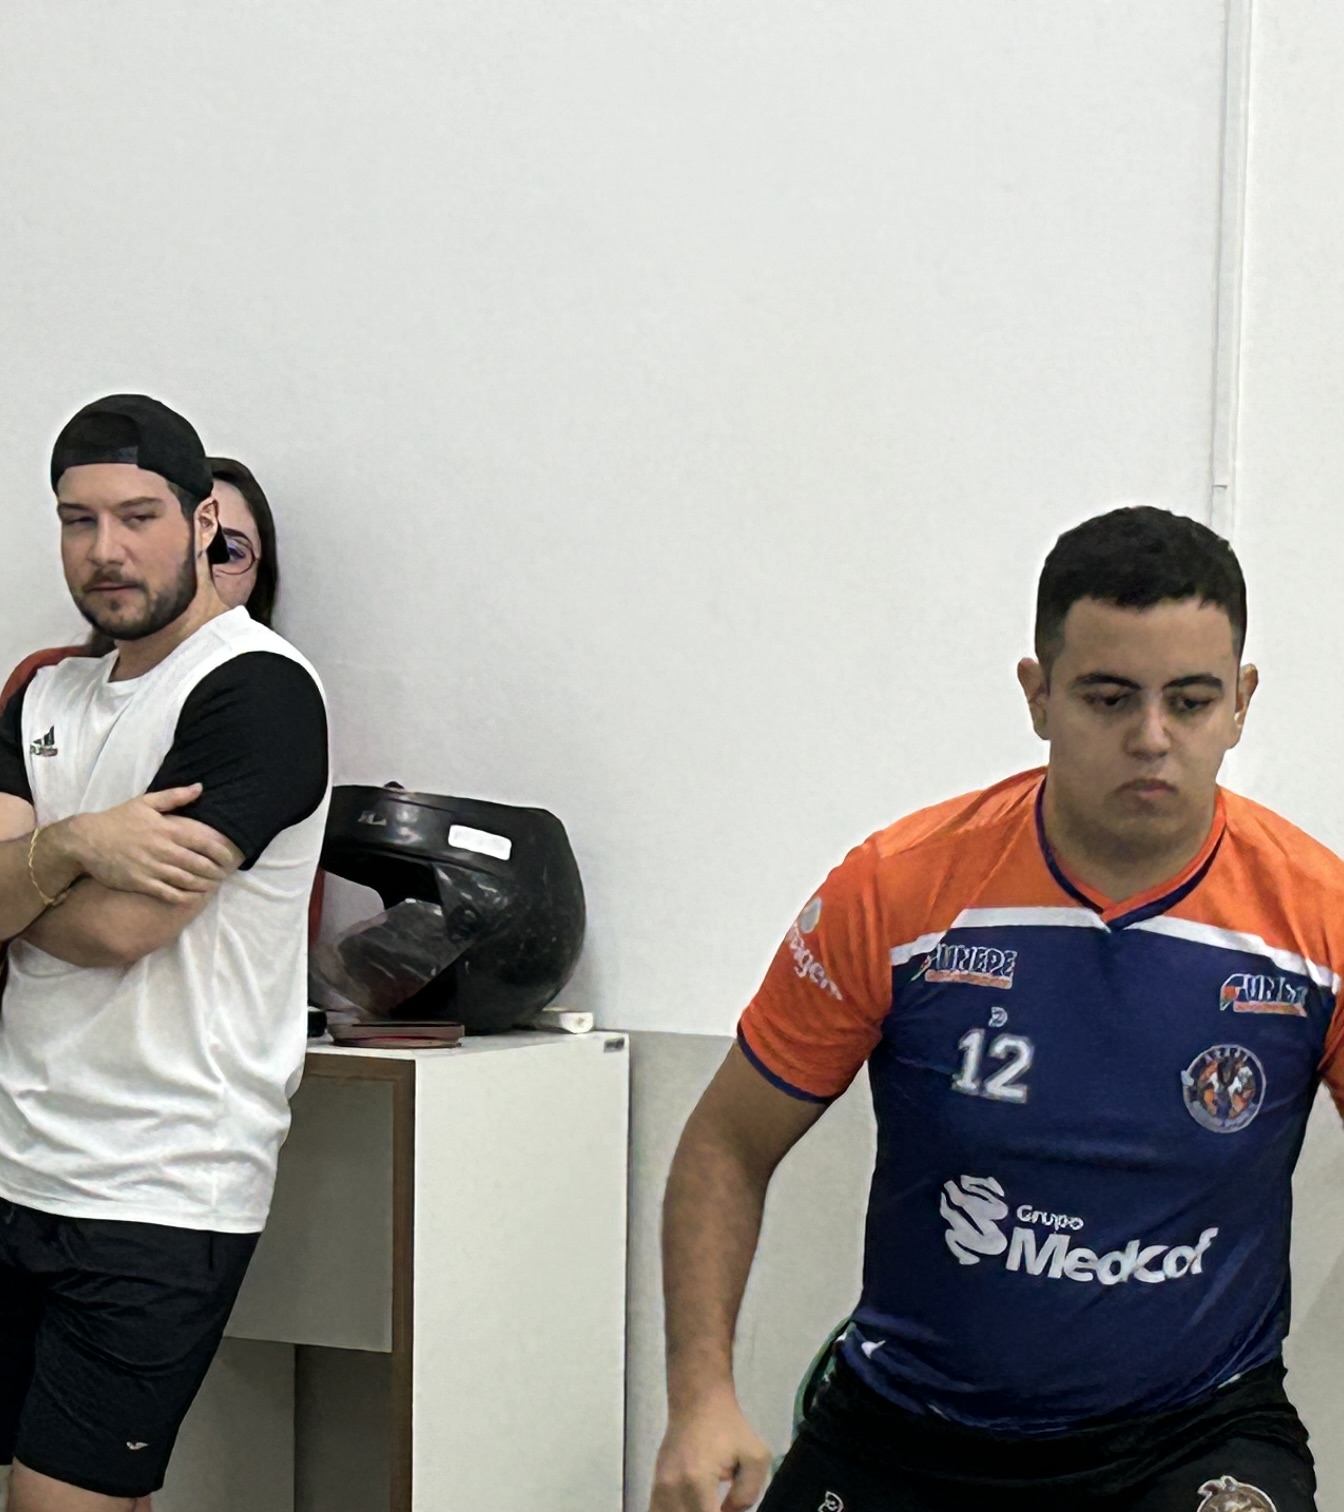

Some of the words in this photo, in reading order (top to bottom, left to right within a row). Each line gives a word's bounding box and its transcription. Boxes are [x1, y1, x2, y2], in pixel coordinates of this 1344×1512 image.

[951, 1028, 1035, 1104] 12
[1016, 1204, 1084, 1230] Grupo
[1006, 1226, 1219, 1285] Medcof
